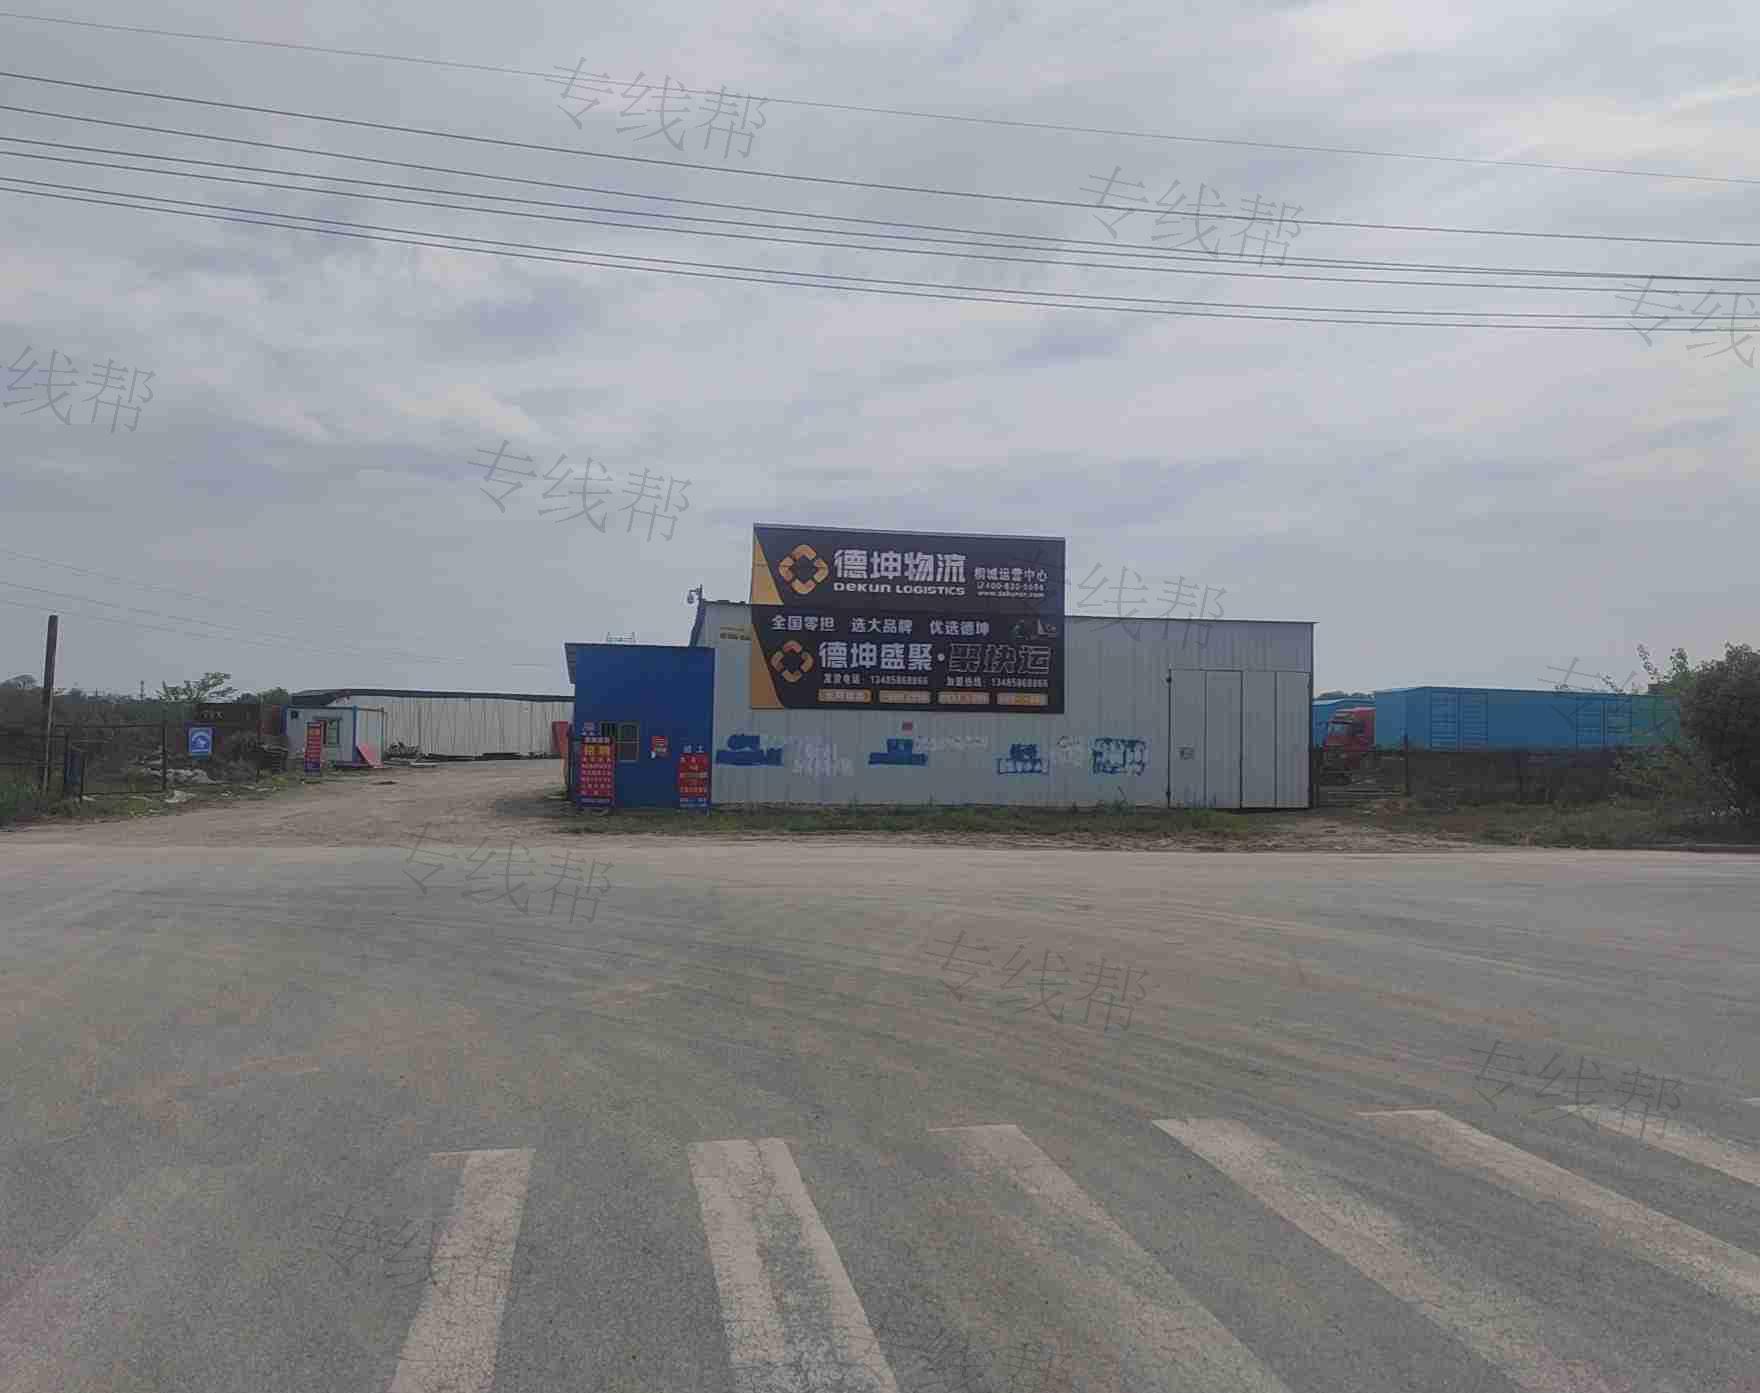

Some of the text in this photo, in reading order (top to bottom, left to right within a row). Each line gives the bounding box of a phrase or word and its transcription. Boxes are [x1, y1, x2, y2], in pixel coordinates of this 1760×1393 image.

[833, 549, 966, 583] 德坤物流
[895, 584, 966, 596] LOGISTICS
[770, 615, 835, 632] 全国零担
[851, 617, 913, 634] 选大品牌
[929, 619, 990, 635] 优选德坤
